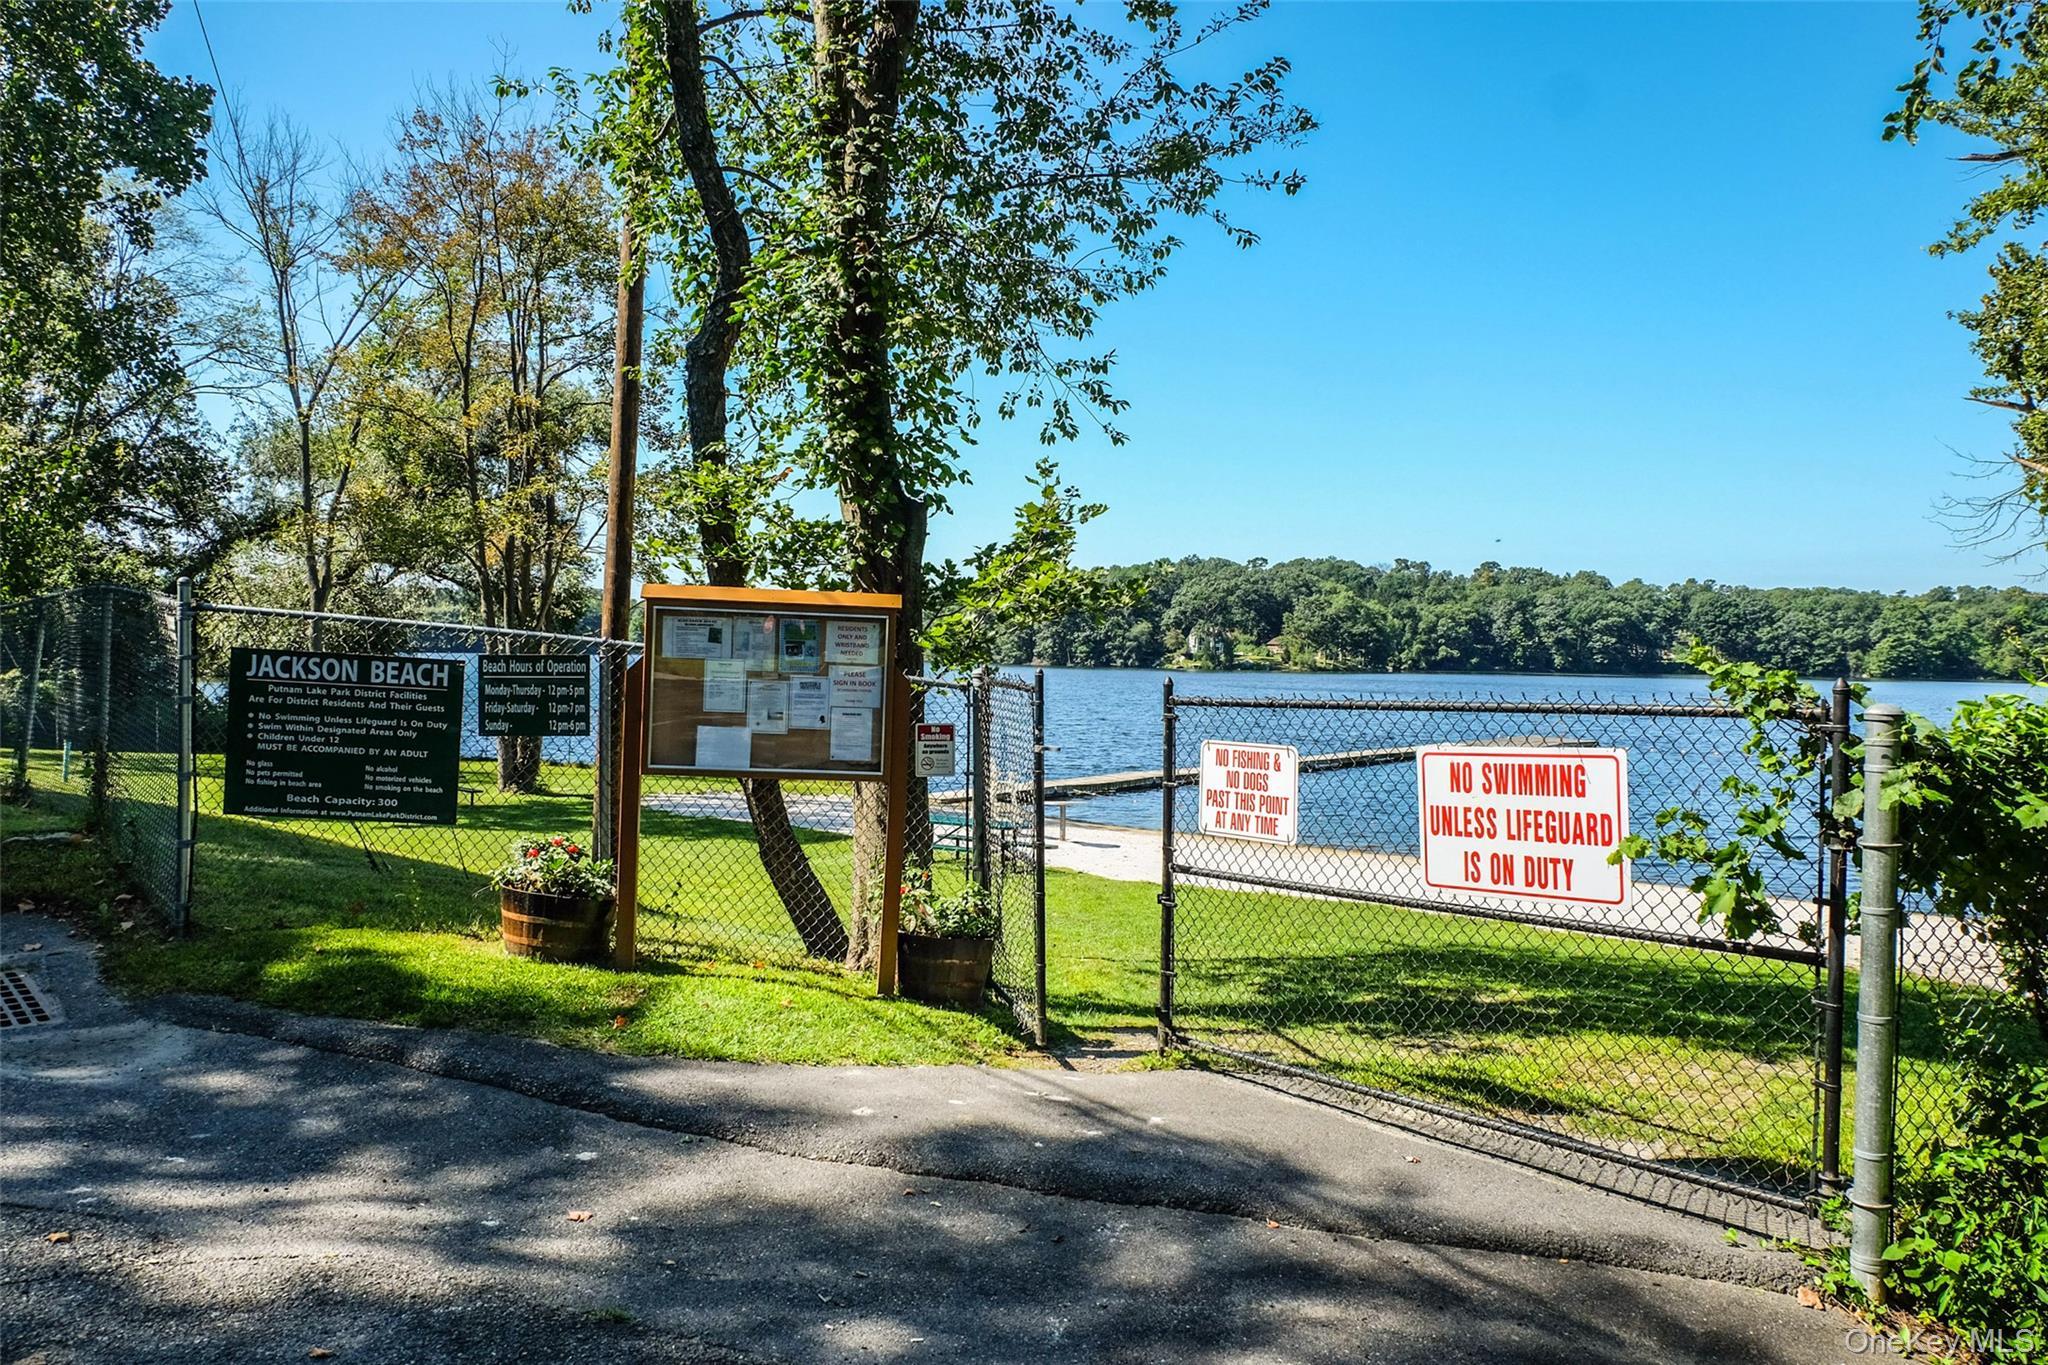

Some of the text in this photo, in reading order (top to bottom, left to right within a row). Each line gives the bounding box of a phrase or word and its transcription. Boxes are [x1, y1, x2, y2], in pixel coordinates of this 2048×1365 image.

[246, 654, 448, 686] JACKSON BEACH
[483, 659, 586, 675] Beach Hours of Operation
[268, 685, 427, 700] Putnam Lake Park District Facilities
[249, 695, 445, 713] Are For District Residents And Their Guests
[258, 712, 447, 730] No Swimming Unless Lifeguard Is On Duty
[258, 722, 417, 739] Swim Within Designated Areas Only
[258, 733, 339, 743] Children Under 12
[257, 743, 282, 751] MUST
[302, 744, 365, 755] ACCOMPANIED
[369, 748, 380, 756] BY
[384, 749, 397, 757] AN
[400, 750, 428, 758] ADULT
[258, 760, 273, 768] glass
[1216, 749, 1281, 771] NO FISHING &
[256, 778, 278, 787] fishing
[375, 784, 401, 793] smoking
[1227, 770, 1268, 792] NO DOGS
[1450, 762, 1586, 798] NO SWIMMING
[287, 794, 398, 808] Beach Capacity: 300
[1206, 789, 1289, 815] PAST THIS POINT
[244, 806, 278, 814] Additional
[330, 810, 438, 820] www.PutnamLakeParkDistrict.com
[1215, 811, 1278, 836] AT ANY TIME
[1430, 805, 1612, 847] UNLESS LIFEGUARD
[1464, 851, 1573, 891] IS ON DUTY
